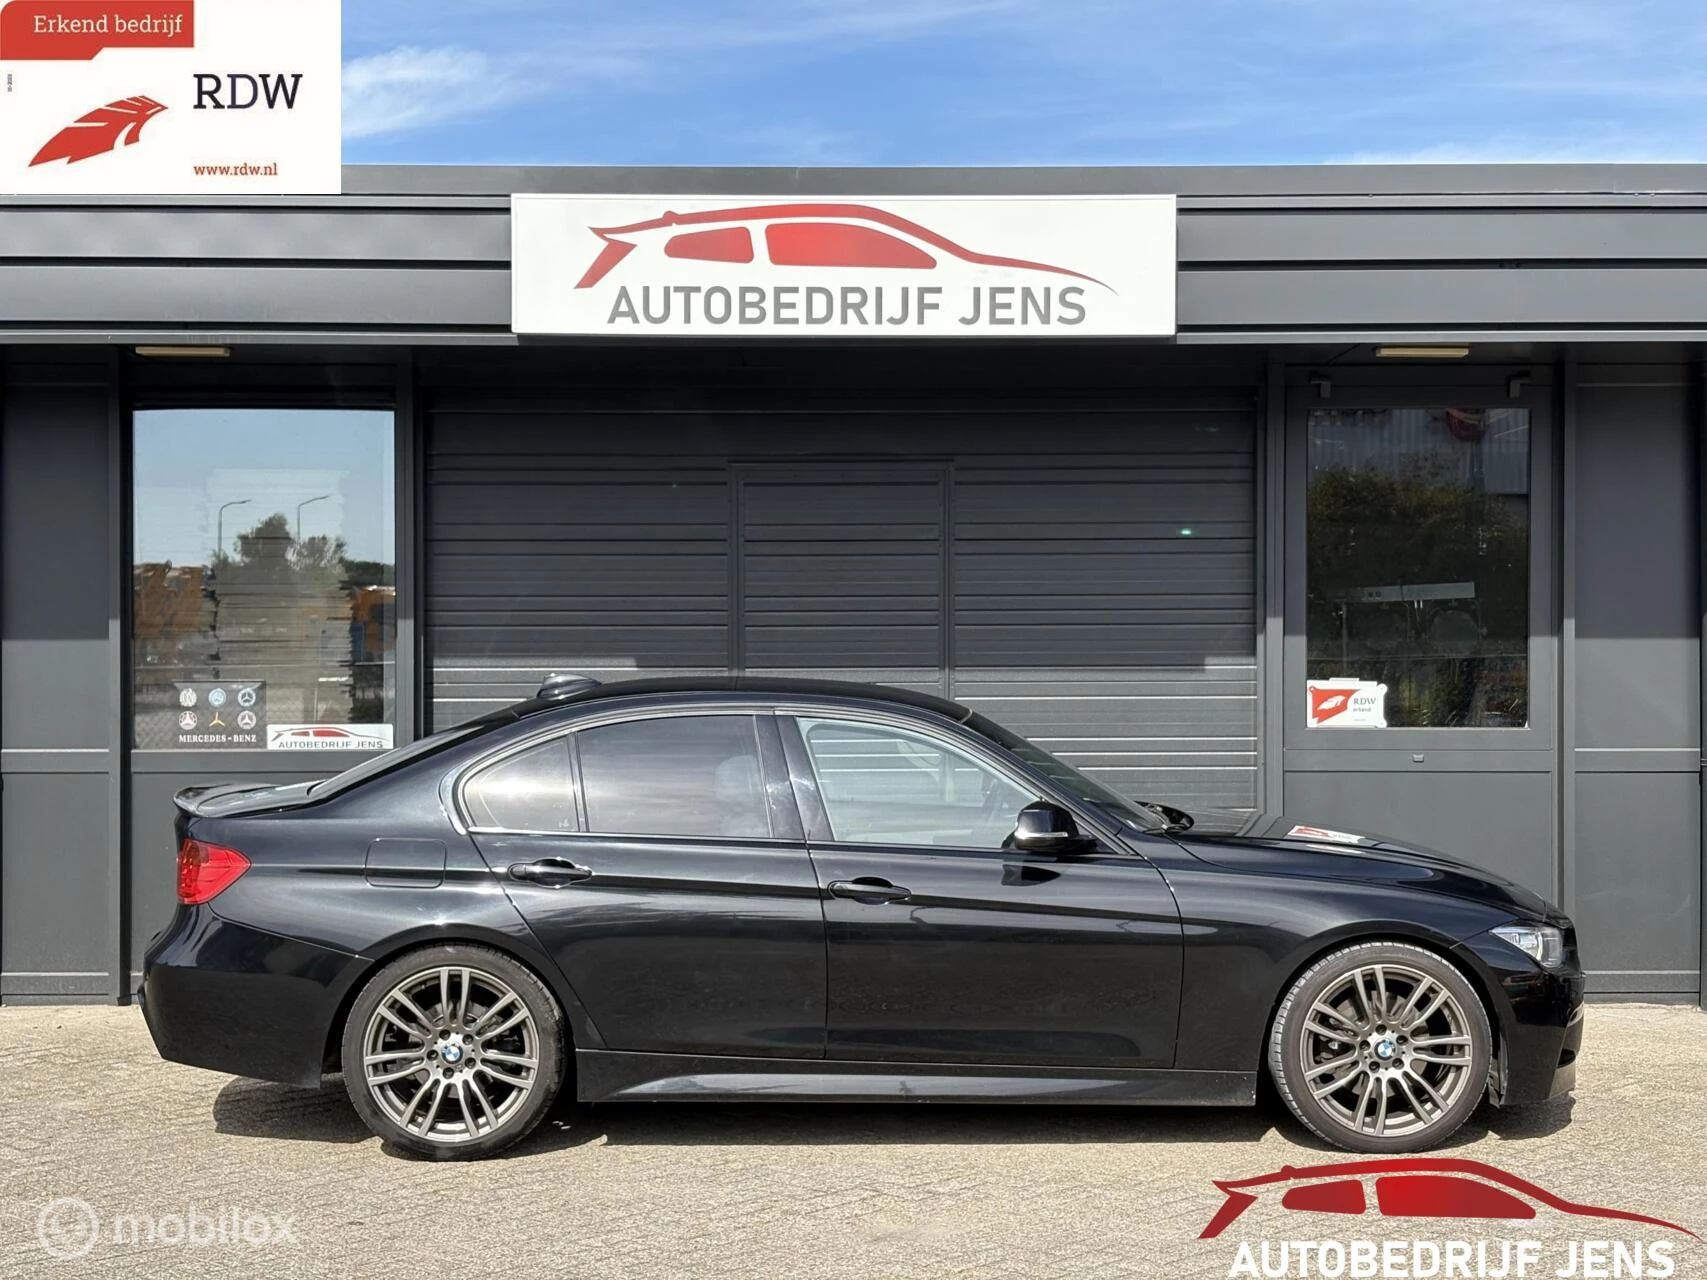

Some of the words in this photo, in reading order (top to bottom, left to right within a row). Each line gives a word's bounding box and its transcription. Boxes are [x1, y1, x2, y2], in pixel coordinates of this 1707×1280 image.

[607, 286, 943, 326] AUTOBEDRIJF
[958, 286, 1086, 326] JENS
[278, 740, 351, 749] AUTOBEDRIJF
[356, 740, 384, 749] JENS
